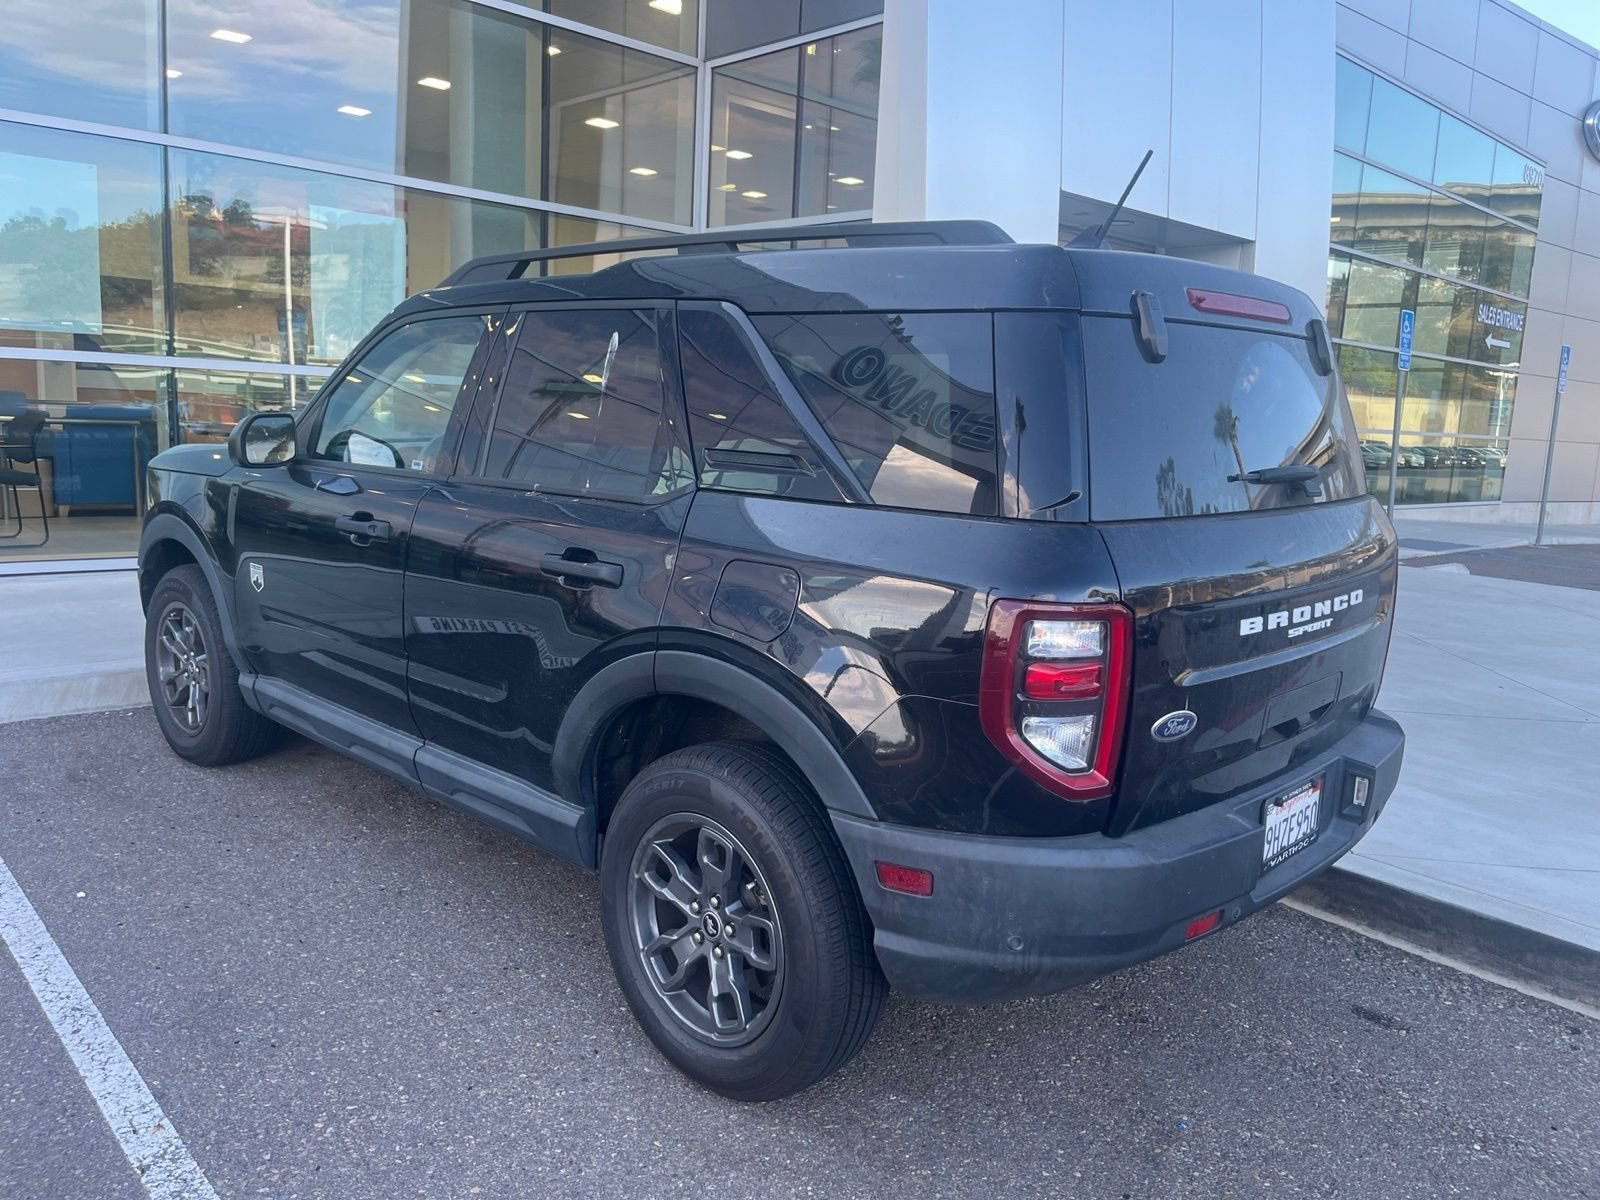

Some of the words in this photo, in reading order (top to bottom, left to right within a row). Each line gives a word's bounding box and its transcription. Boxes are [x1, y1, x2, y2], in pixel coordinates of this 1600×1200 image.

[1523, 163, 1544, 188] 8970
[1478, 303, 1496, 326] SALES
[1496, 307, 1524, 332] ENTRANCE
[1240, 589, 1363, 636] BRONCO
[1287, 618, 1334, 638] SPORT
[1163, 717, 1190, 736] Ford
[1265, 800, 1318, 860] 9HZF950
[1269, 839, 1310, 867] WARTHOG
